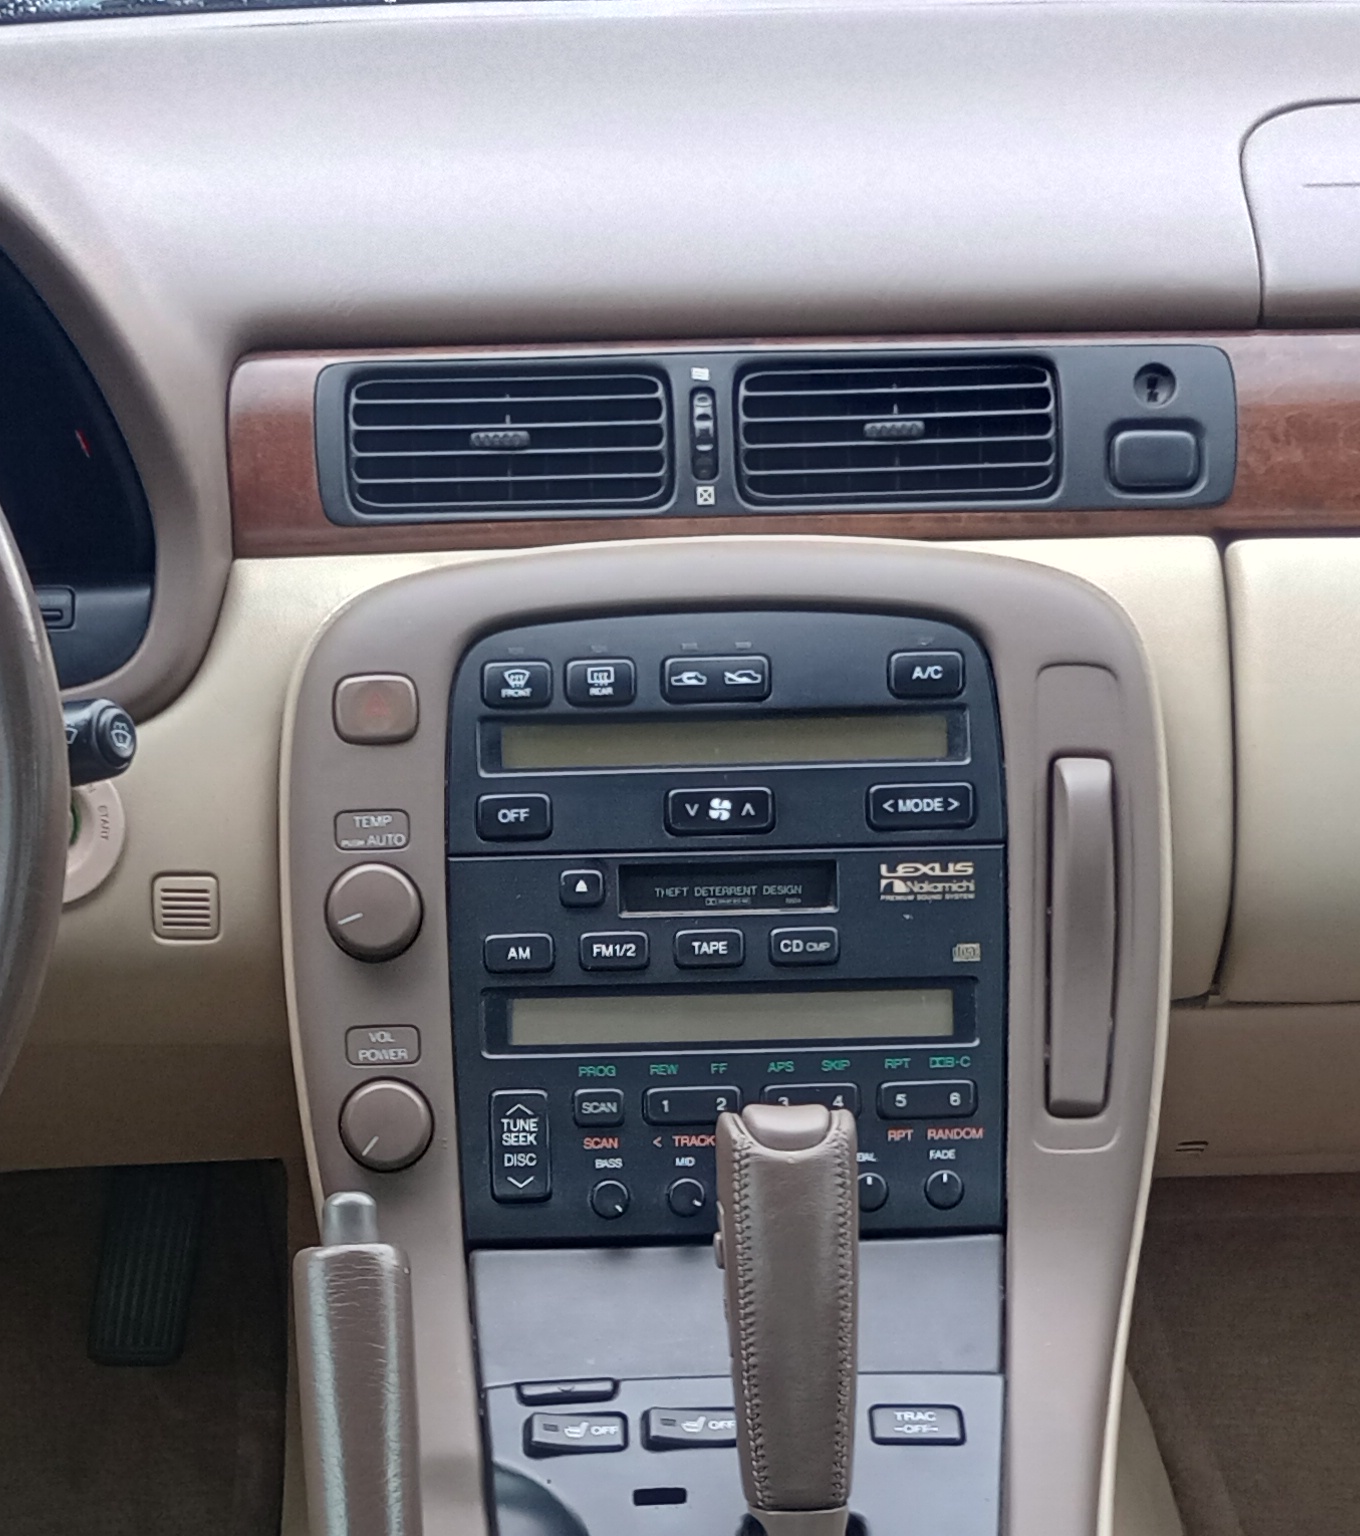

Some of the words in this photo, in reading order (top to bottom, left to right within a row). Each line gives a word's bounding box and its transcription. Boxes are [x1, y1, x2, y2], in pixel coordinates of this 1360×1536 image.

[911, 666, 943, 680] A/C
[501, 687, 532, 698] FRONT
[589, 687, 614, 696] REAR
[897, 798, 945, 813] MODE
[497, 808, 530, 823] OFF
[352, 815, 393, 829] TEMP
[366, 833, 407, 847] AUTO
[880, 862, 975, 877] LEXUS
[654, 887, 690, 898] THEFT
[694, 885, 758, 897] DETERRENT
[762, 884, 803, 895] DESIGN
[906, 879, 976, 893] Nakamichi
[691, 941, 728, 955] TAPE
[779, 939, 804, 953] CD
[507, 947, 531, 961] AM
[368, 1031, 396, 1043] VOL
[358, 1049, 408, 1062] POWER
[649, 1064, 679, 1075] REW
[710, 1063, 728, 1074] FF
[767, 1061, 795, 1072] APS
[820, 1060, 851, 1072] SKIP
[884, 1058, 911, 1069] RPT
[578, 1066, 617, 1077] PROG
[661, 1100, 669, 1113] 1
[716, 1097, 728, 1111] 2
[832, 1095, 844, 1107] 4
[895, 1093, 907, 1107] 5
[949, 1092, 961, 1106] 6
[581, 1102, 618, 1114] SCAN
[501, 1118, 539, 1132] TUNE
[502, 1133, 538, 1146] SEEK
[887, 1129, 913, 1141] RPT
[927, 1127, 984, 1141] RANDOM
[583, 1137, 619, 1149] SCAN
[672, 1135, 716, 1147] TRACK
[503, 1154, 537, 1167] DISC
[856, 1152, 877, 1162] BAL
[929, 1149, 956, 1160] FADE
[595, 1158, 623, 1169] BASS
[675, 1157, 696, 1167] MID
[893, 1411, 937, 1421] TRAC
[591, 1425, 619, 1435] OFF
[708, 1419, 736, 1430] OFF
